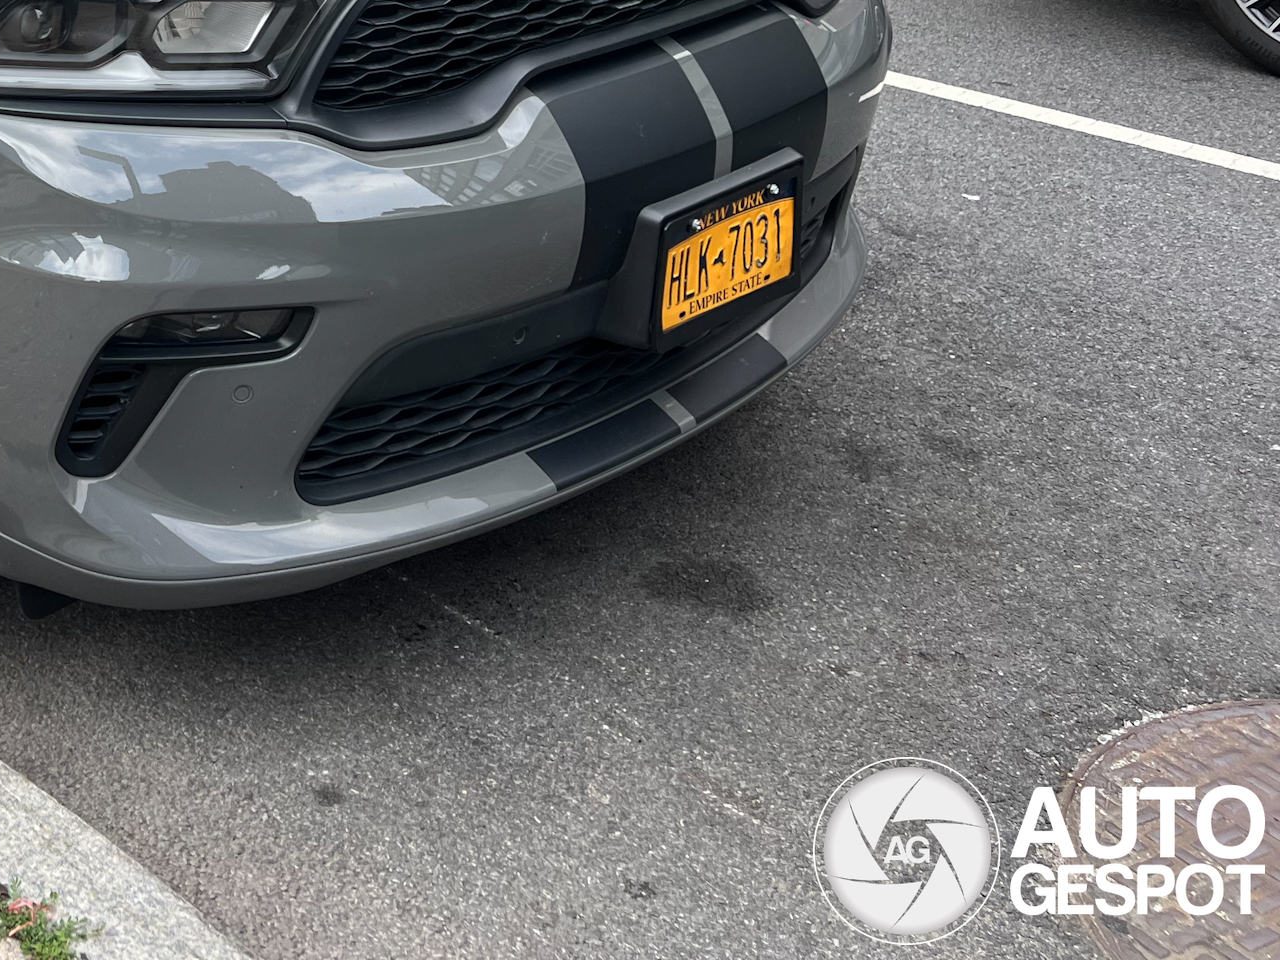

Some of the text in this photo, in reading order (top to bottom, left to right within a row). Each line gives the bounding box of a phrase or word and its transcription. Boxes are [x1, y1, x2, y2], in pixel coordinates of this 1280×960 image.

[696, 189, 766, 232] NEW YORK
[689, 272, 763, 315] EMPIRE STATE
